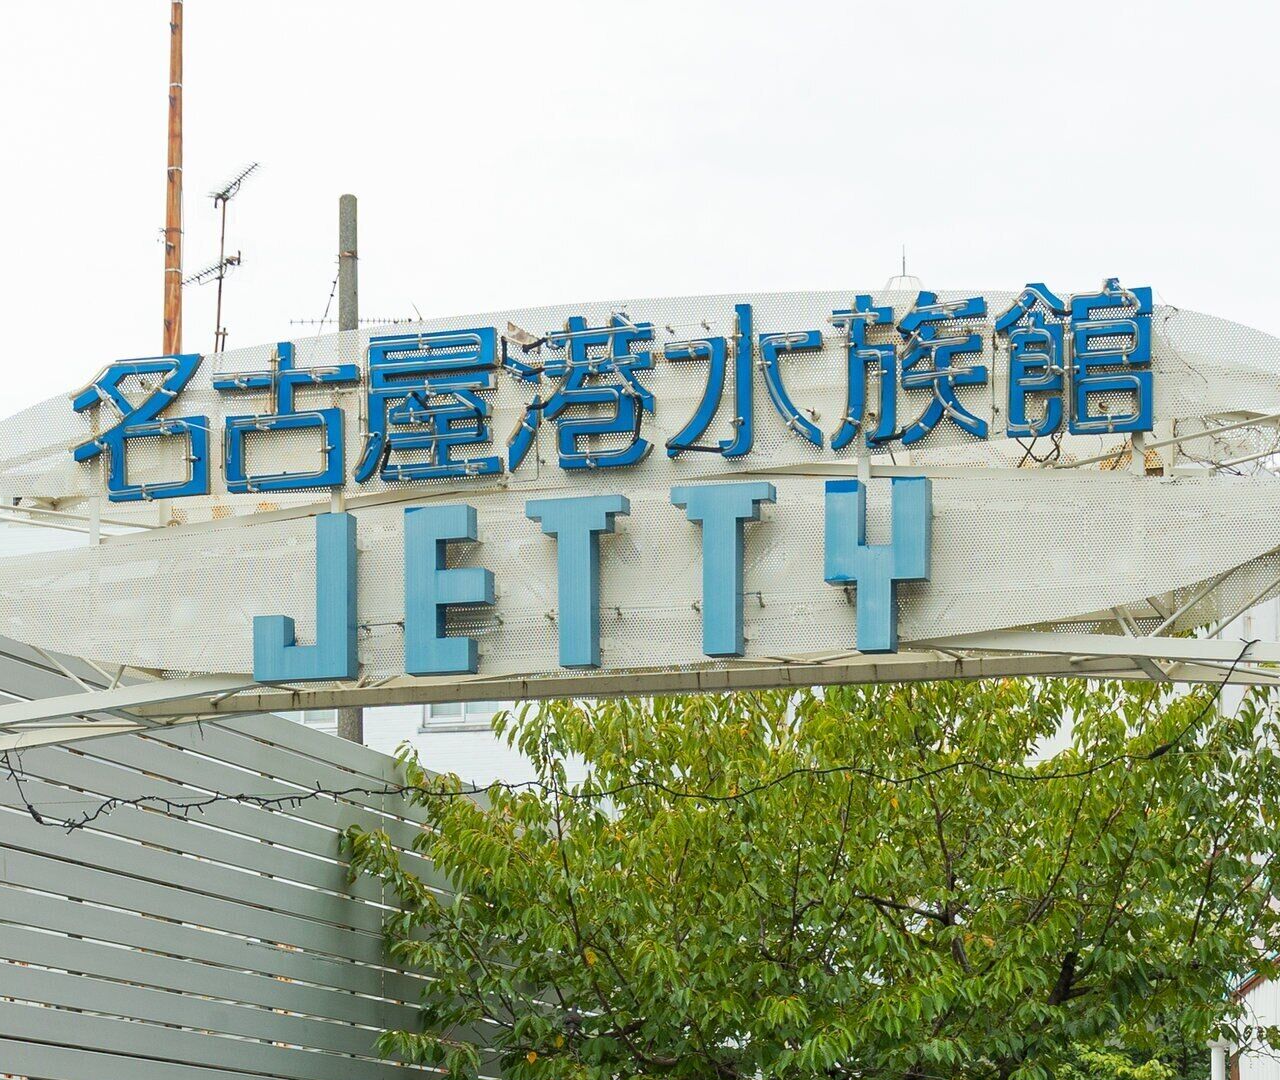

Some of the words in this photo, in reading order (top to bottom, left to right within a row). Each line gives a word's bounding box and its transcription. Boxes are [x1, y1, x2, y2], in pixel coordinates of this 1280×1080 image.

[70, 279, 1154, 502] 名古屋港水族館
[253, 476, 933, 682] JETTY
